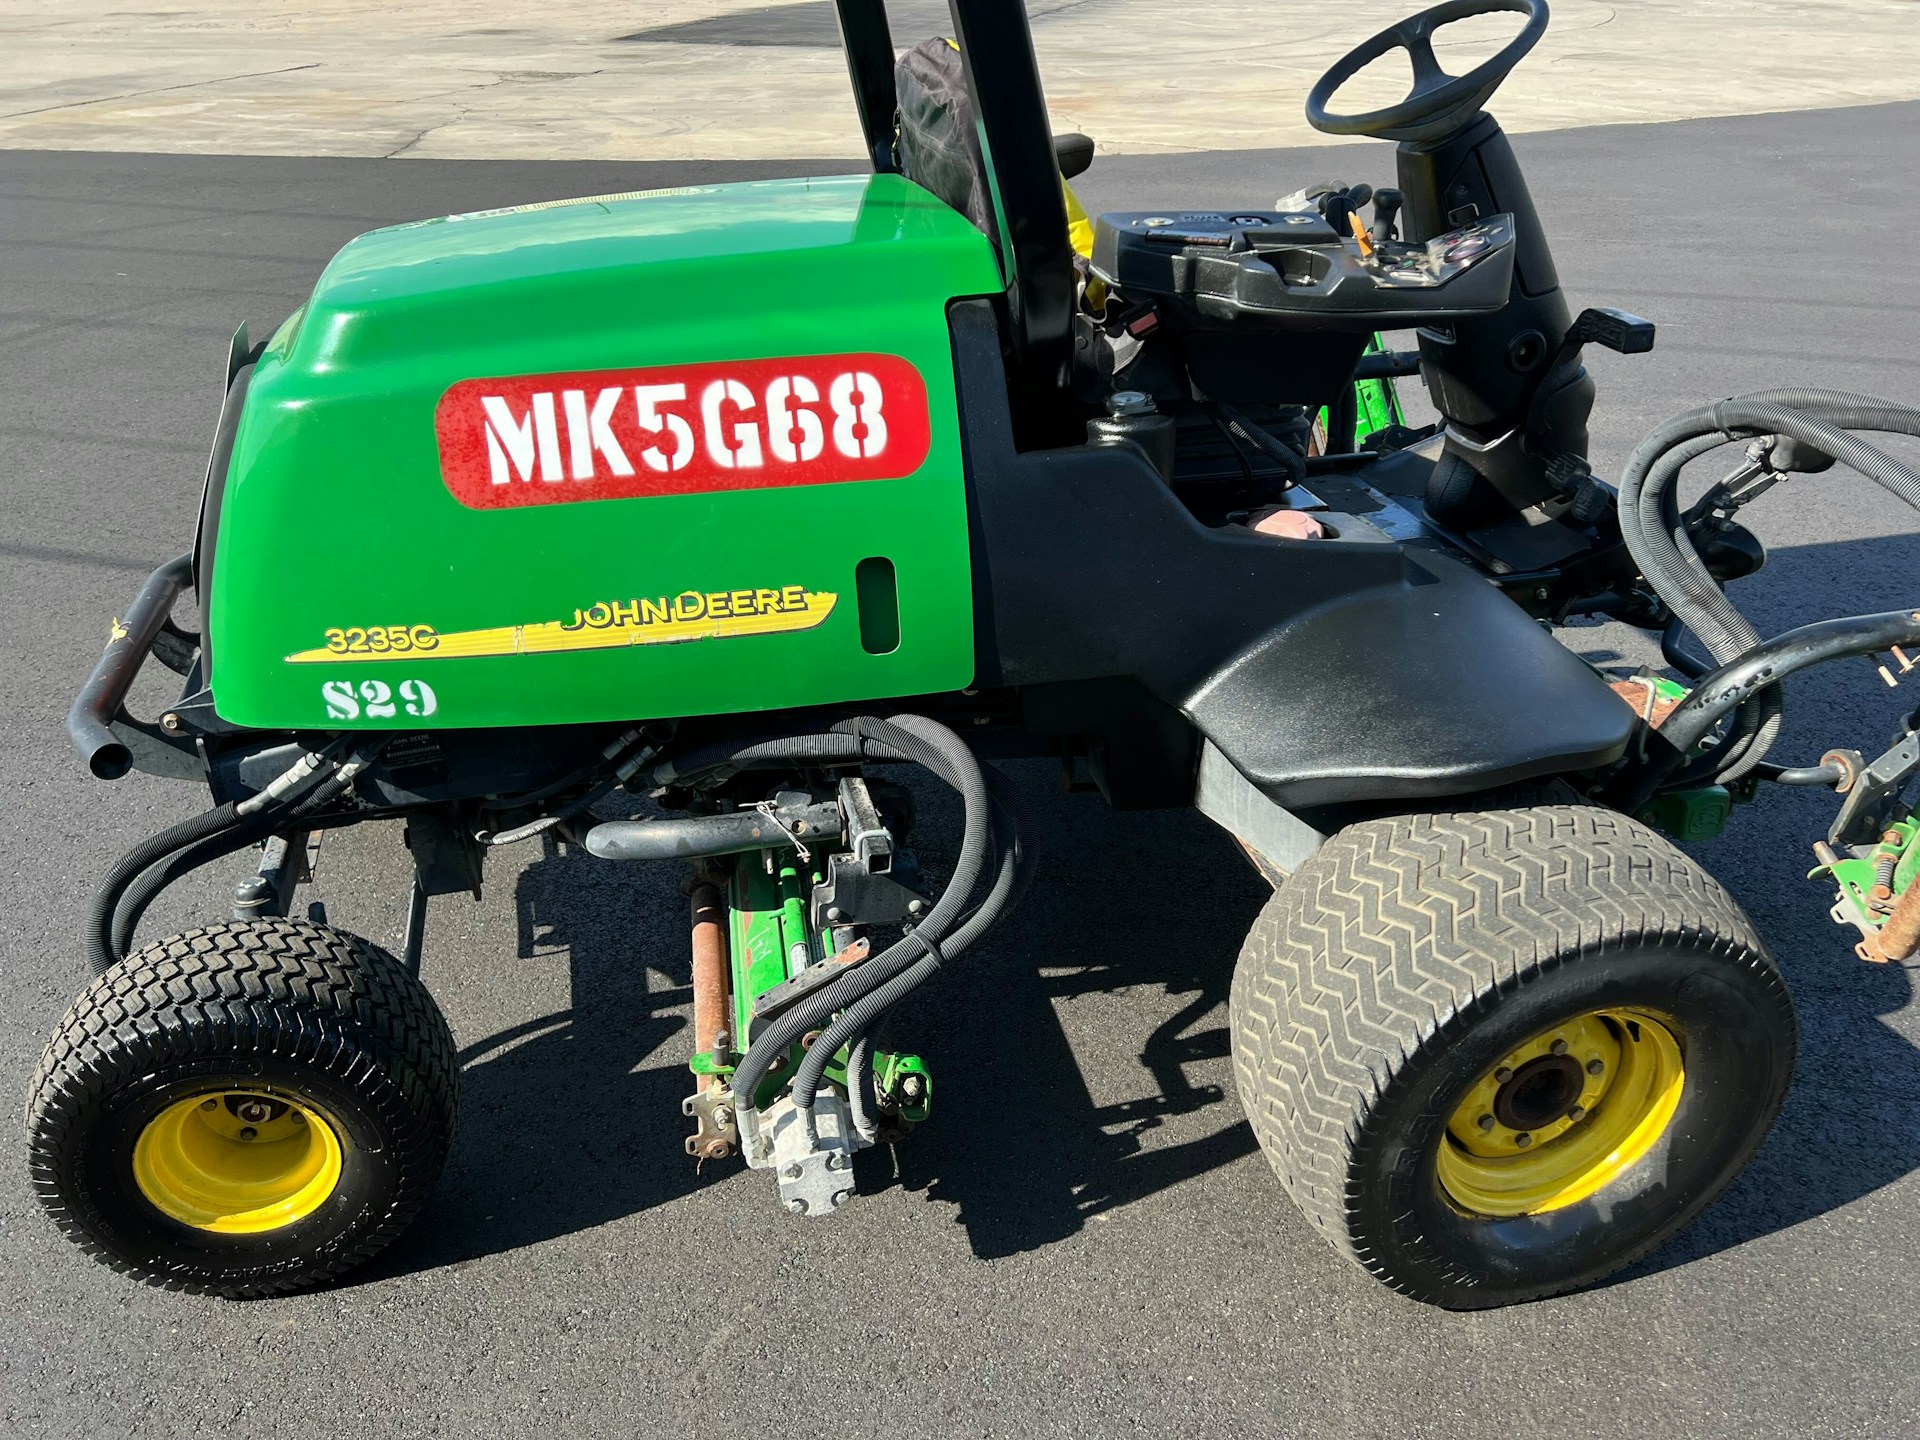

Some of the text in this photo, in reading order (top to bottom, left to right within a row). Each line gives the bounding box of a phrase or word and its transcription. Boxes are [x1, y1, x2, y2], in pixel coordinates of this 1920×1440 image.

[480, 372, 888, 485] MK5G68
[561, 585, 810, 631] JOHN DEERE
[325, 623, 440, 654] 3235C
[321, 680, 438, 719] S29
